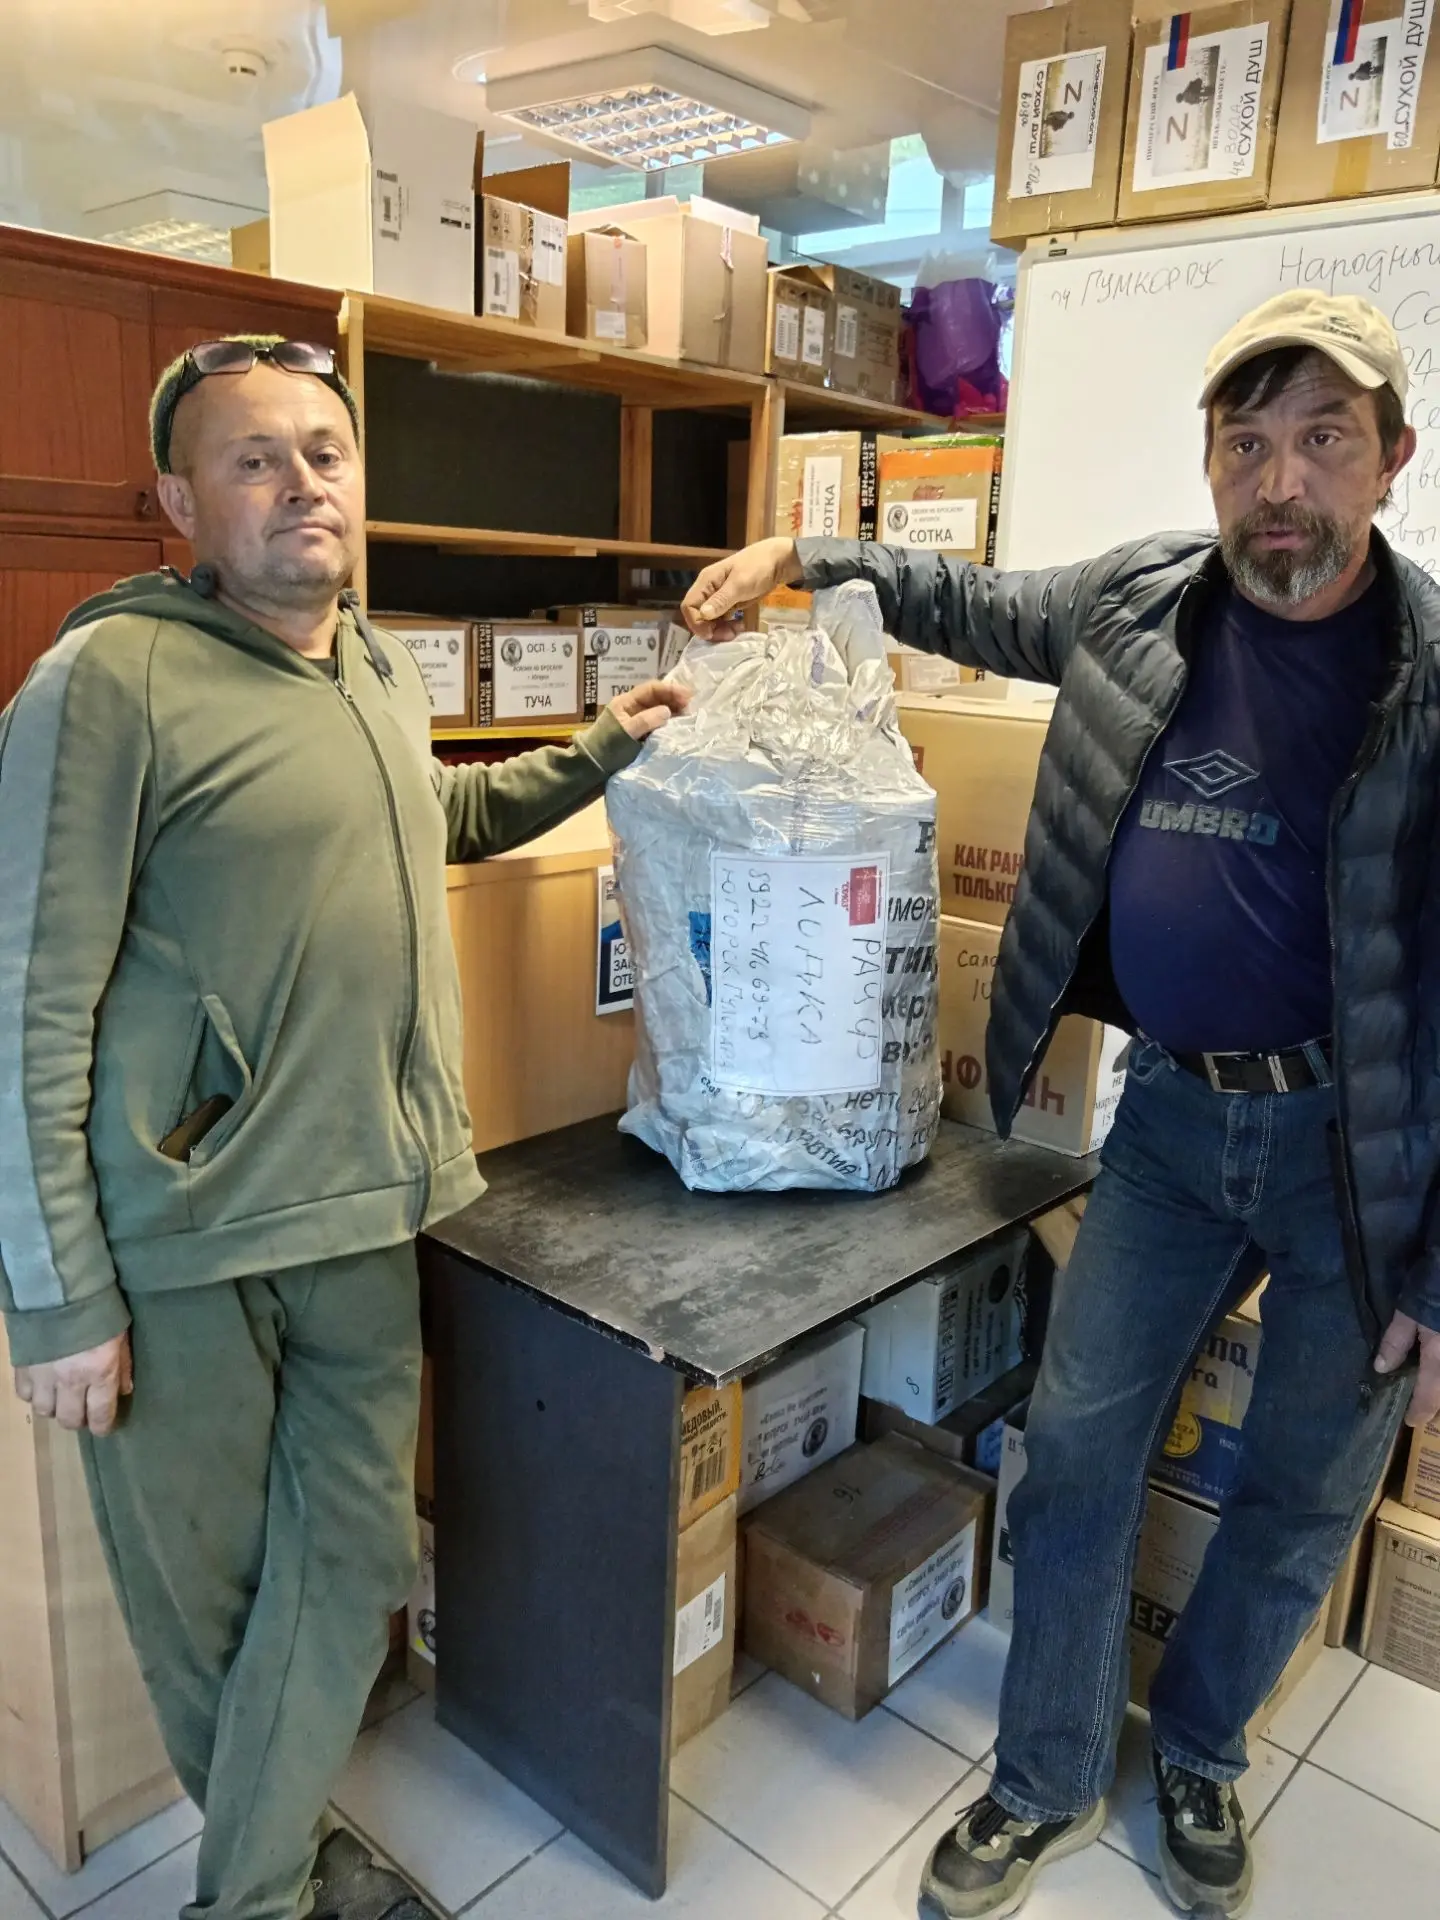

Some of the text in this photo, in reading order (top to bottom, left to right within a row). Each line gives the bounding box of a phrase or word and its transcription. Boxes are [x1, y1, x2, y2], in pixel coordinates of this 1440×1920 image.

[1394, 0, 1426, 125] СУХОЙ ДУШ
[1028, 70, 1044, 155] СУХОЙ ДУШ
[1237, 38, 1263, 157] СУХОЙ ДУШ
[822, 484, 836, 537] СОТКА
[909, 528, 953, 544] СОТКА
[433, 639, 440, 649] 4
[526, 643, 557, 653] ОСП 5
[614, 635, 642, 645] ОСП 6
[524, 695, 552, 709] ТУЧА
[1139, 800, 1280, 845] UMBRO
[954, 843, 989, 871] КАК
[720, 867, 742, 976] ЮГОРСК
[795, 887, 826, 1045] ЛОДКА
